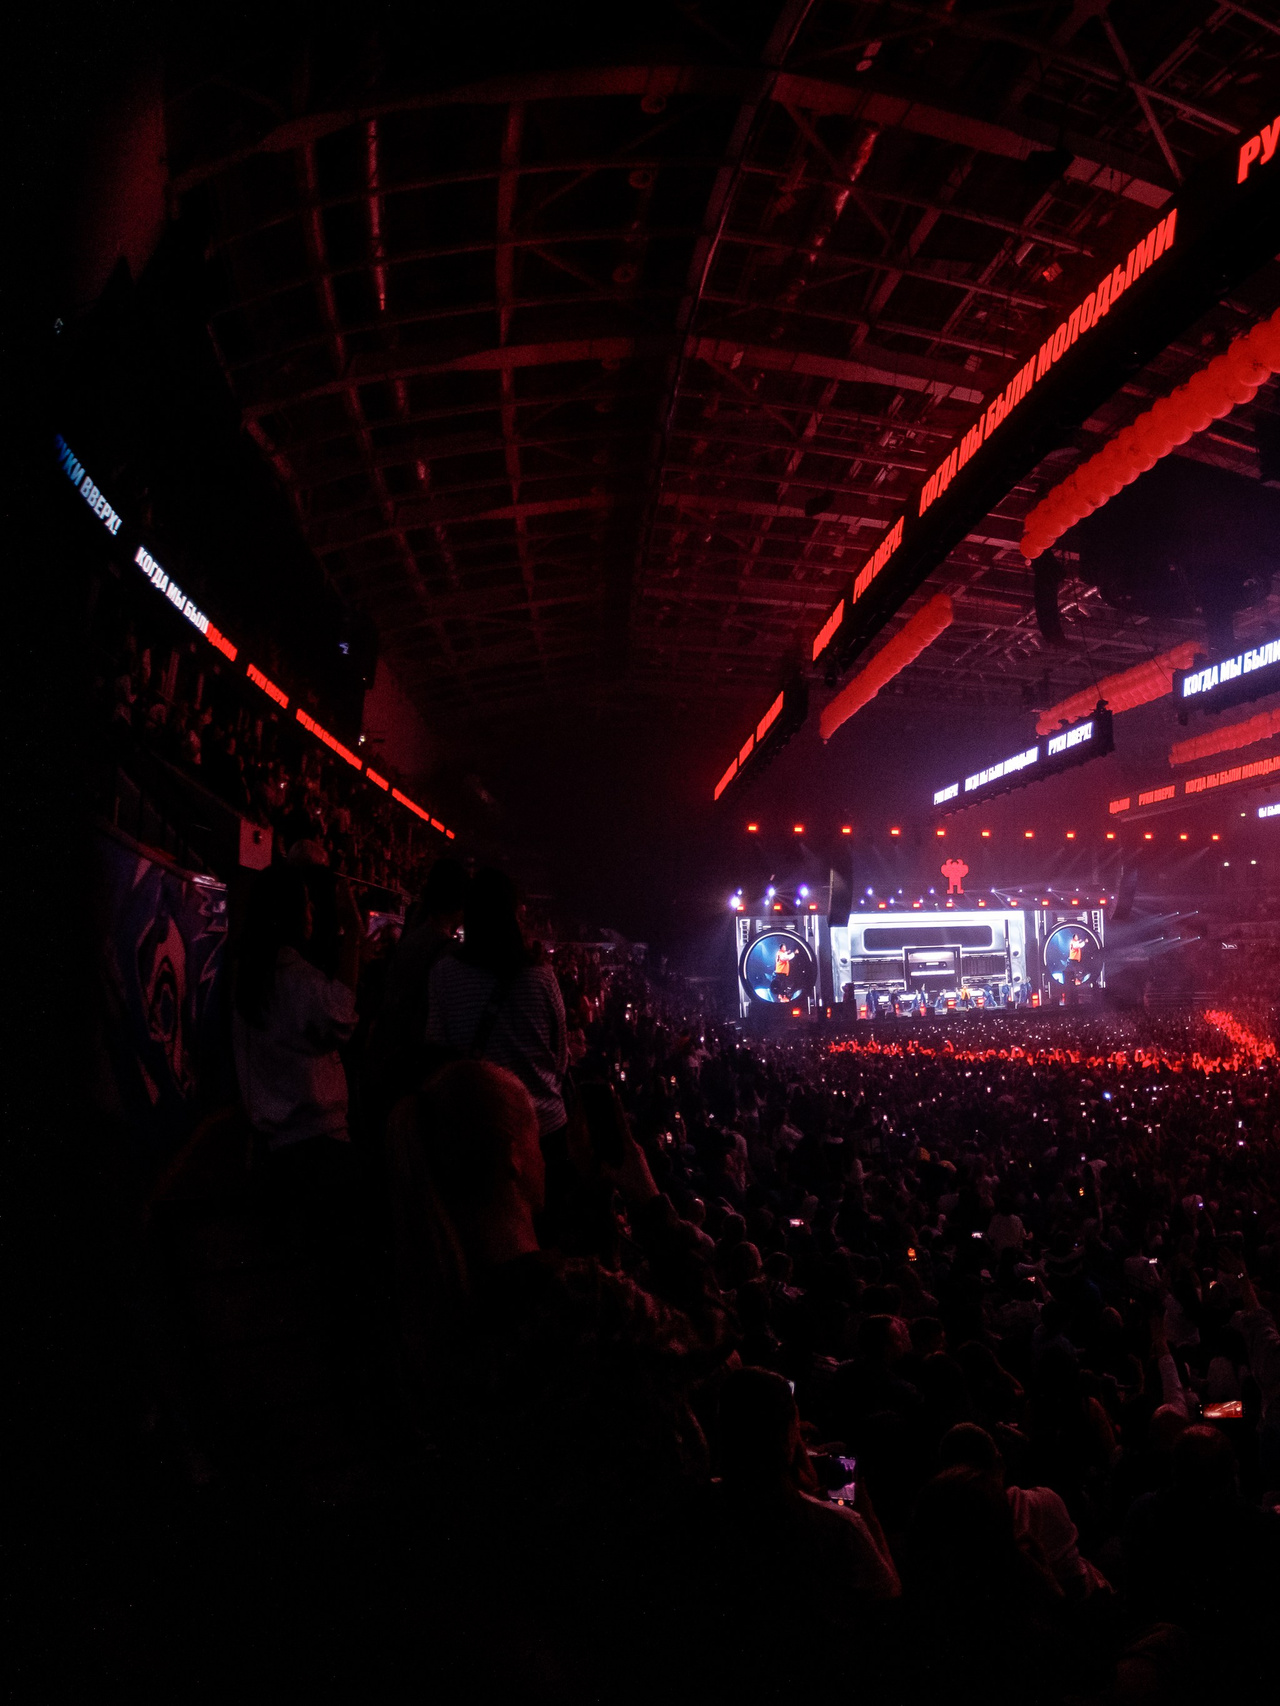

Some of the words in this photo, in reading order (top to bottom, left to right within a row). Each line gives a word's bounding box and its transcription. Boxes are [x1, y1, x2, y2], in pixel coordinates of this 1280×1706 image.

[919, 447, 958, 517] КОГДА
[958, 414, 985, 471] МЫ
[984, 355, 1036, 440] БЫЛИ
[1036, 208, 1178, 381] МОЛОДЫМИ
[80, 475, 123, 535] ВВЕРХ!
[135, 546, 170, 593] КОГДА
[166, 582, 187, 611] МЫ
[1183, 664, 1219, 698] КОГДА
[1219, 655, 1242, 683] МЫ
